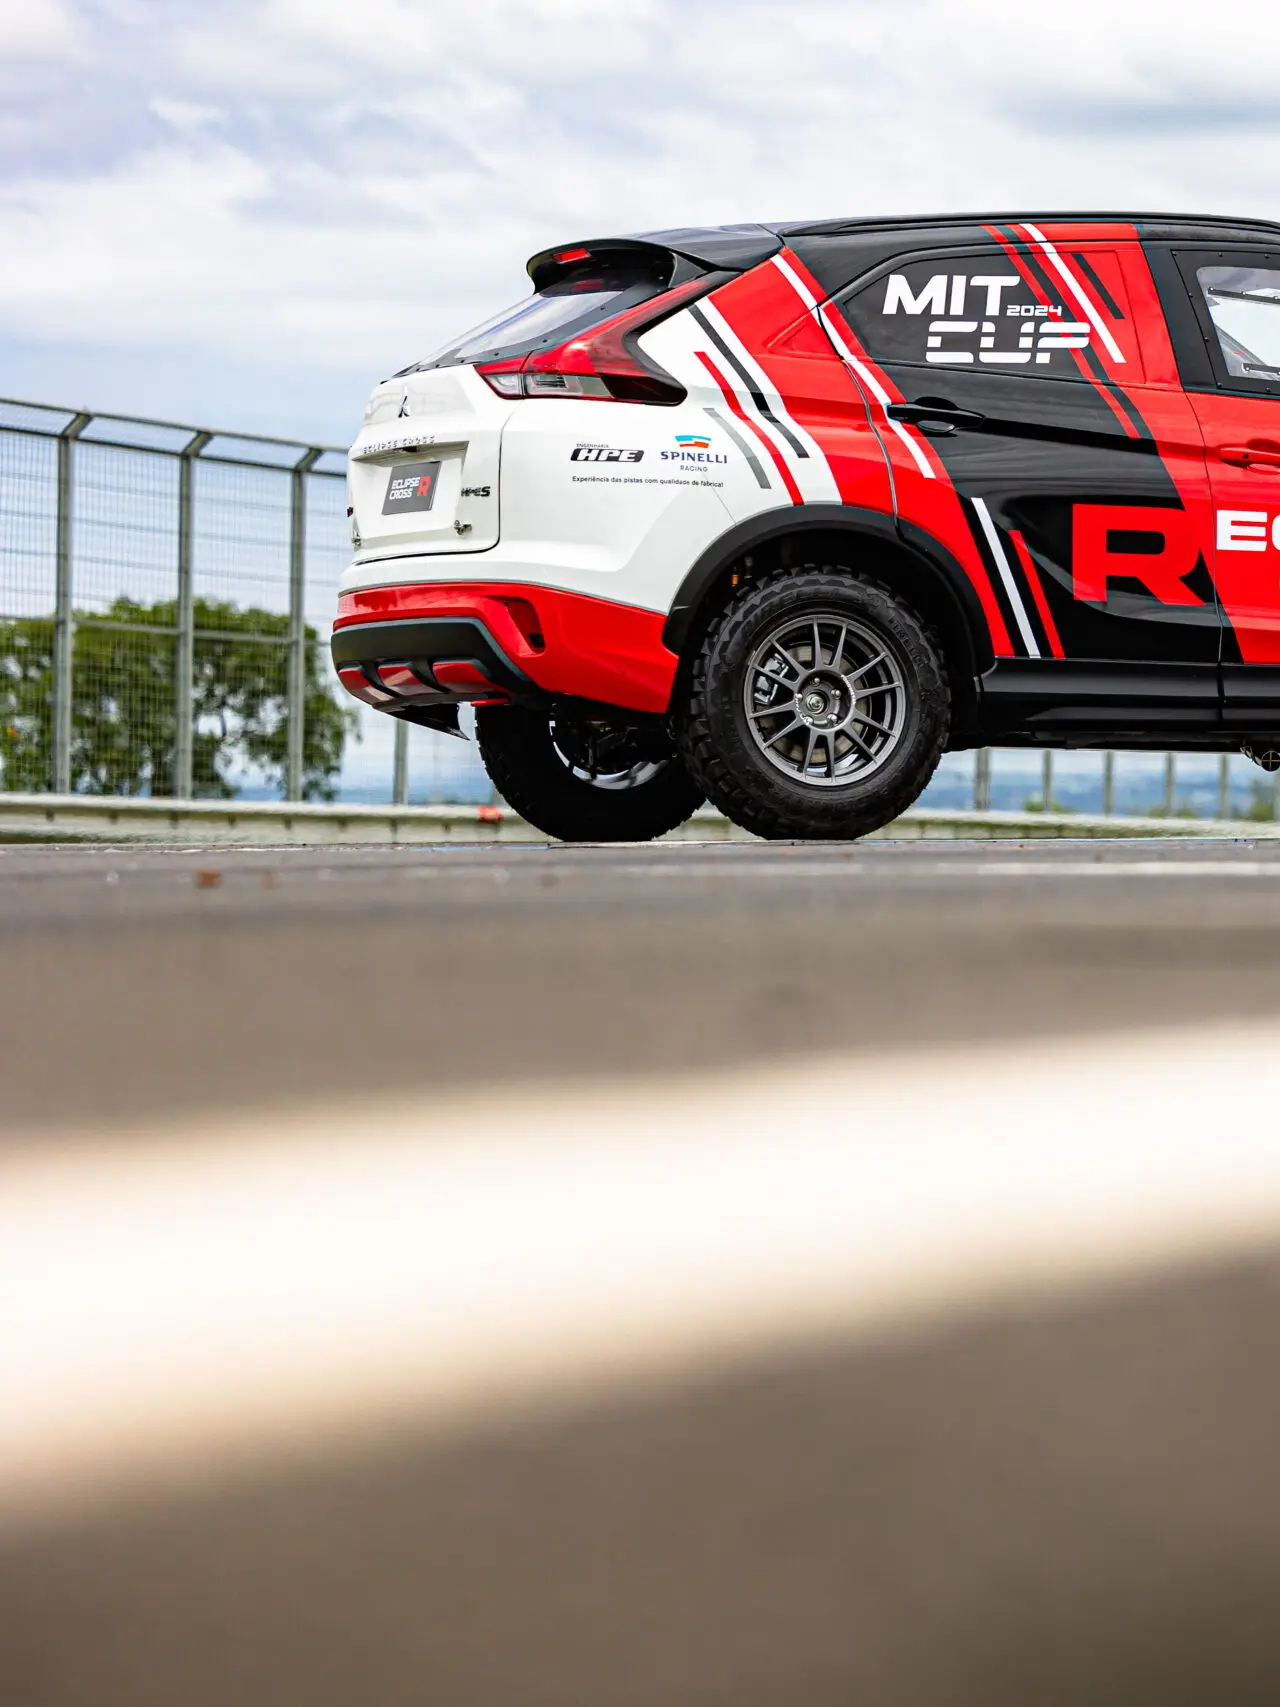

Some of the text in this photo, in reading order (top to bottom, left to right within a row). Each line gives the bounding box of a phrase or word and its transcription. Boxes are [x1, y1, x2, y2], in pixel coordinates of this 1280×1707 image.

[882, 274, 1062, 317] MIT 2024
[925, 320, 1091, 364] CUP
[576, 449, 639, 462] HPE
[660, 450, 728, 465] SPINELLI
[679, 464, 709, 473] RACING
[391, 476, 421, 490] ECLIPSE
[416, 475, 431, 497] R
[623, 477, 643, 485] pistas
[659, 478, 690, 487] qualidade
[389, 487, 413, 500] CROSS
[1072, 502, 1207, 606] R
